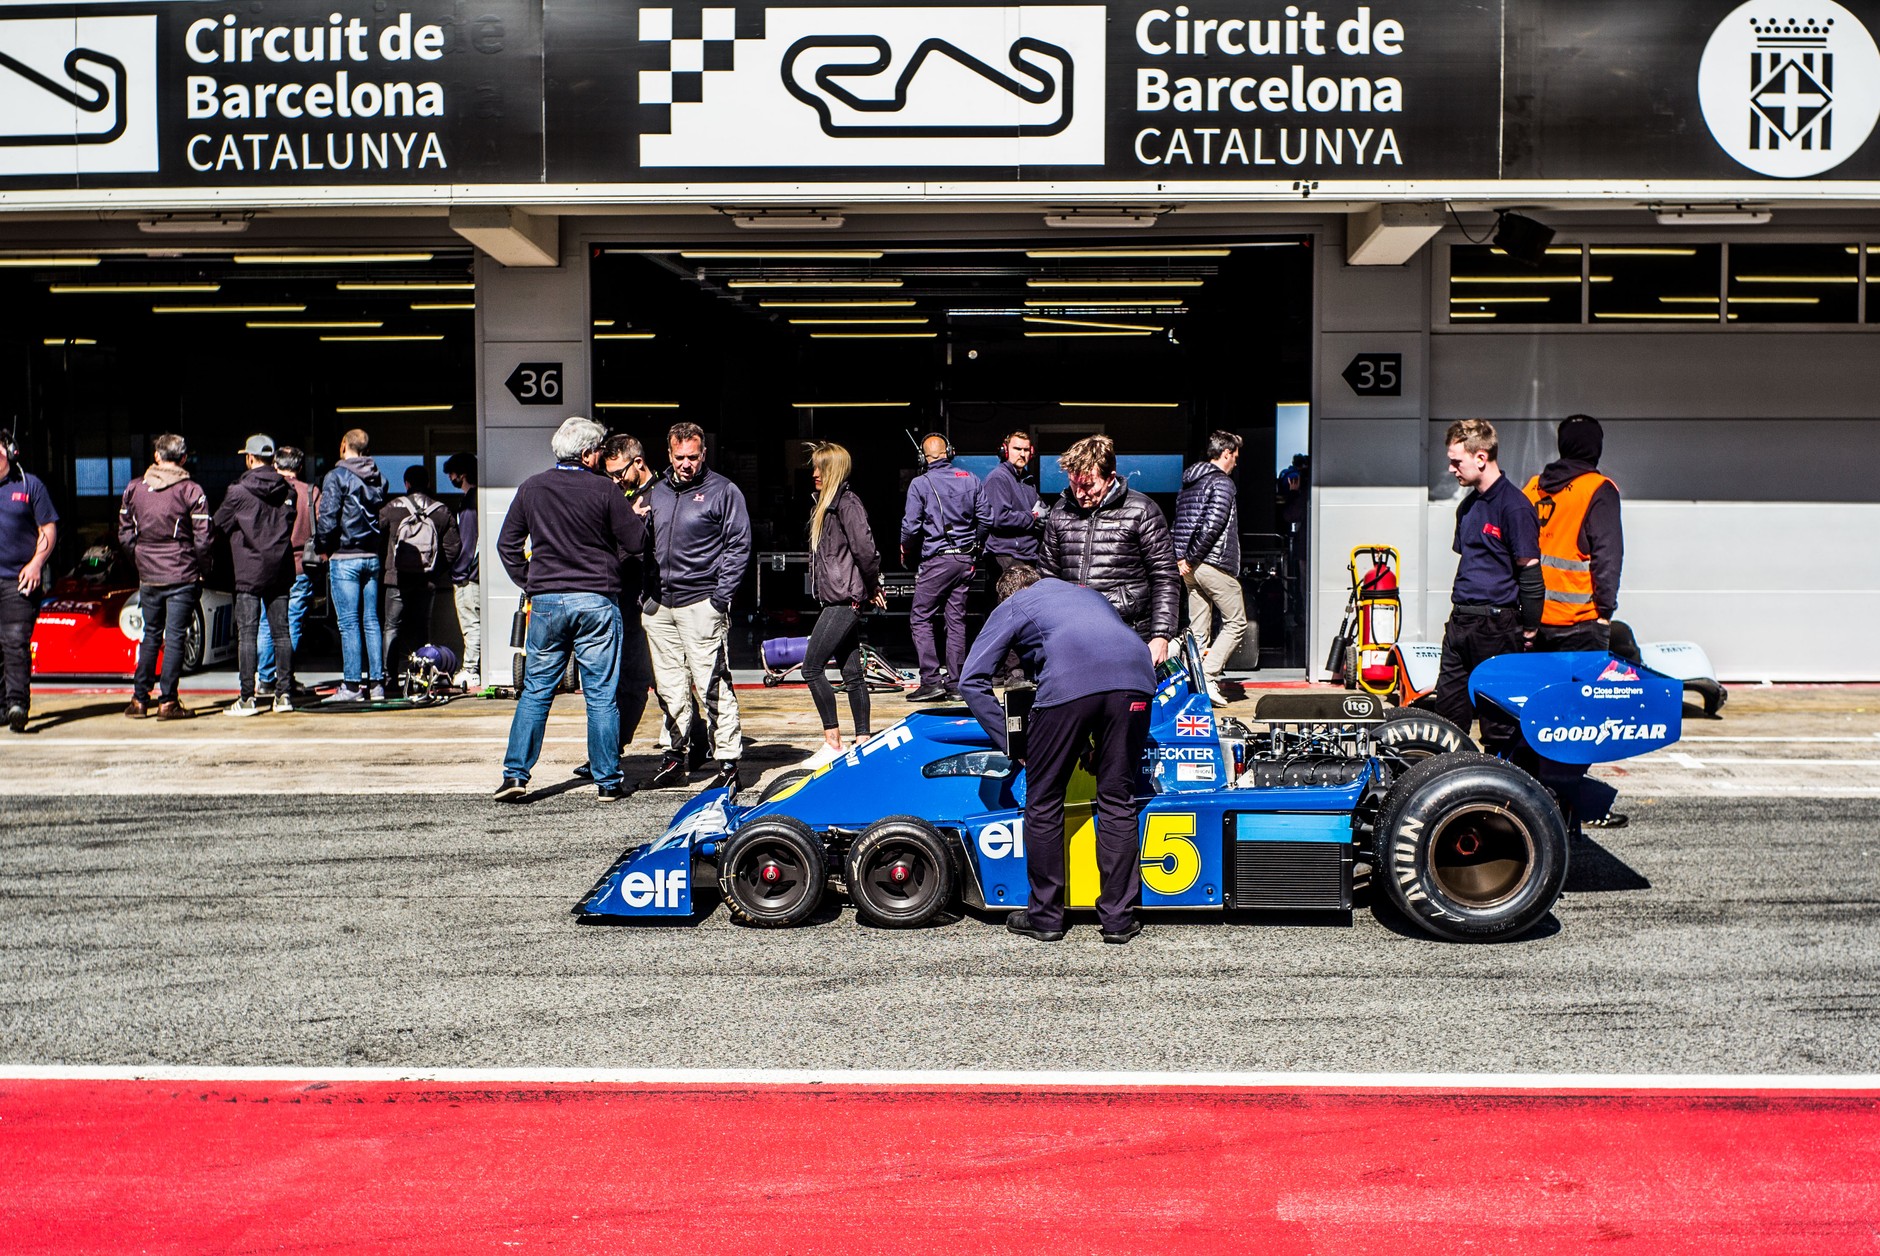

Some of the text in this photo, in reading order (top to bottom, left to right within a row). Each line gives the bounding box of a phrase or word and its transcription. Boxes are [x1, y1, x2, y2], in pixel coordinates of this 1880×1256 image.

[185, 13, 444, 63] Circuit de
[1135, 6, 1405, 56] Circuit de
[186, 70, 444, 119] Barcelona
[1136, 65, 1403, 112] Barcelona
[186, 132, 448, 172] CATALUNYA
[1134, 127, 1403, 166] CATALUNYA
[519, 369, 559, 399] 36
[1356, 360, 1397, 389] 35
[1386, 723, 1461, 753] AVON
[1537, 719, 1667, 746] GOODYEAR
[978, 820, 1024, 859] el
[1140, 812, 1202, 896] 5
[1396, 816, 1426, 901] AVON
[620, 869, 687, 908] elf
